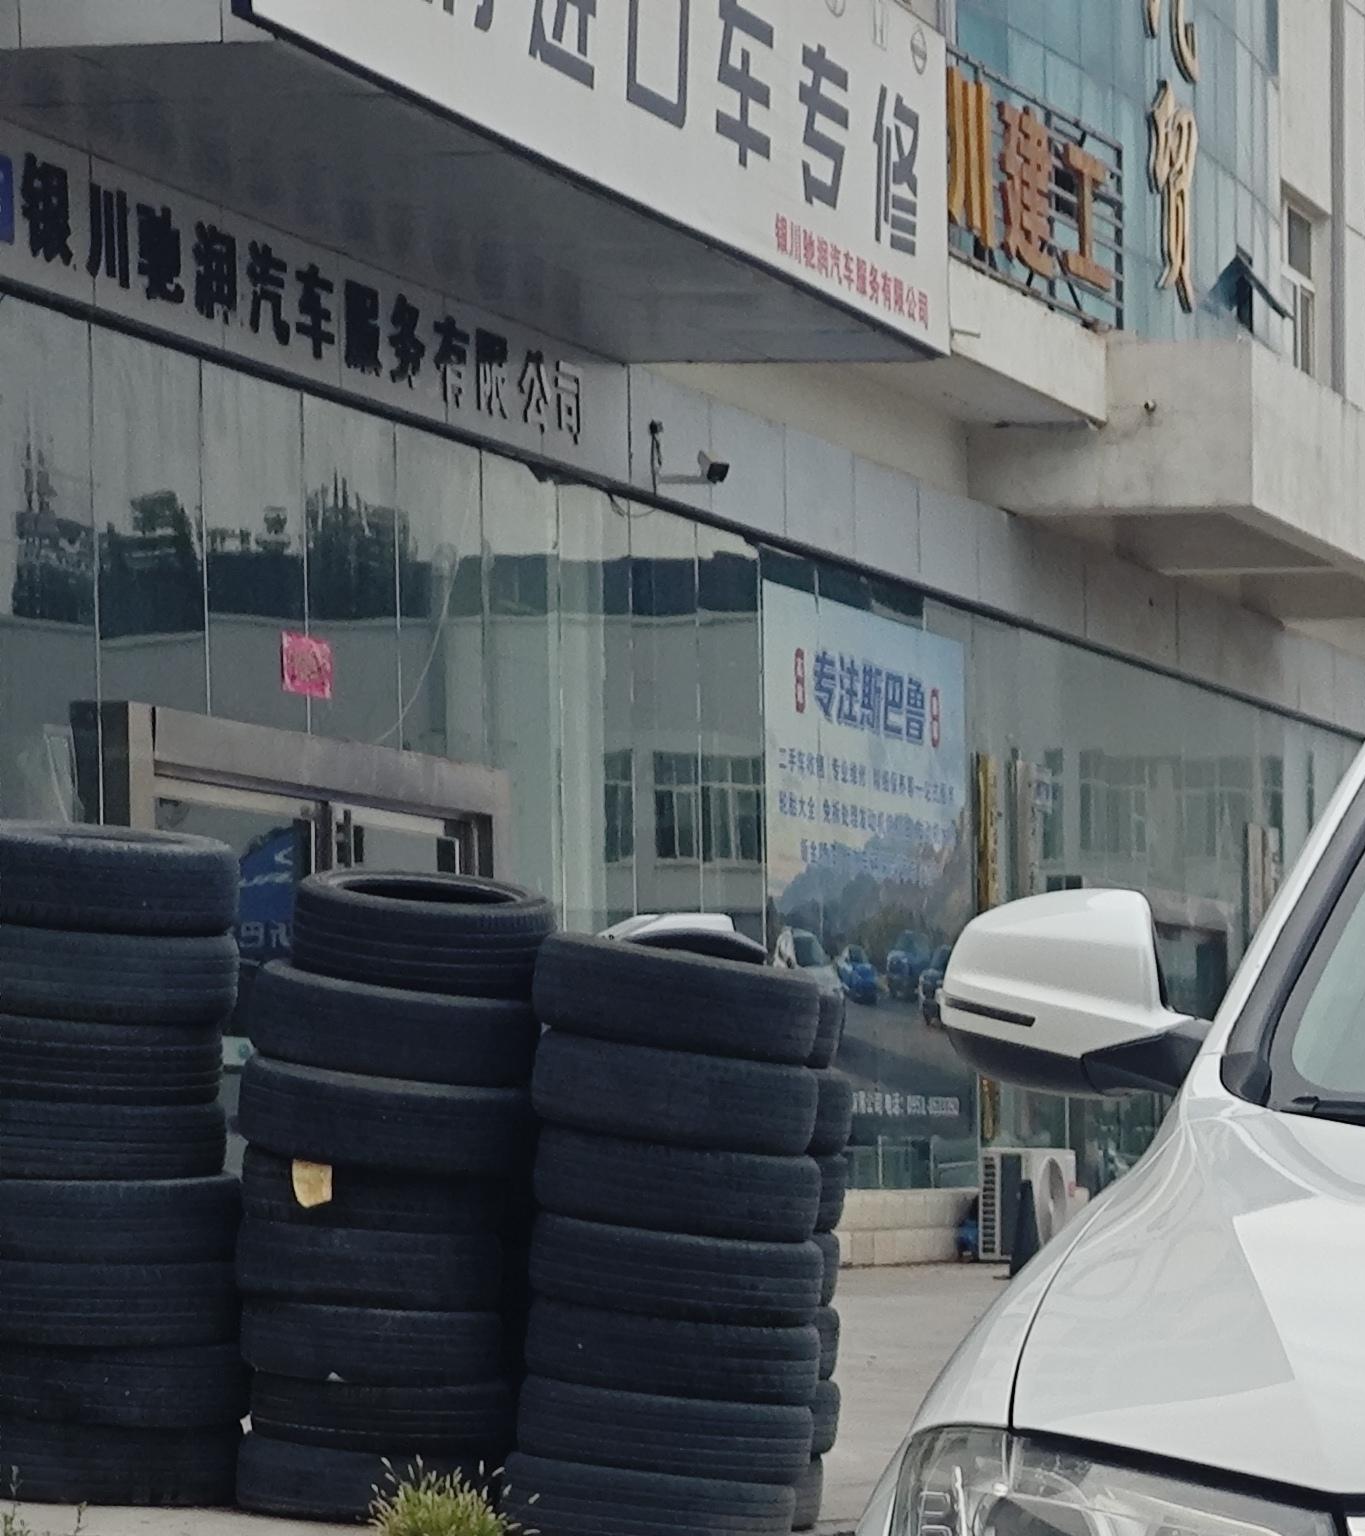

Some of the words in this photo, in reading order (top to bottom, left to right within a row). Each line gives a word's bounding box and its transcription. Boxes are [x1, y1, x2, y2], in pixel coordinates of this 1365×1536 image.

[426, 0, 919, 256] 进口车专修
[813, 650, 925, 744] 专注斯巴鲁
